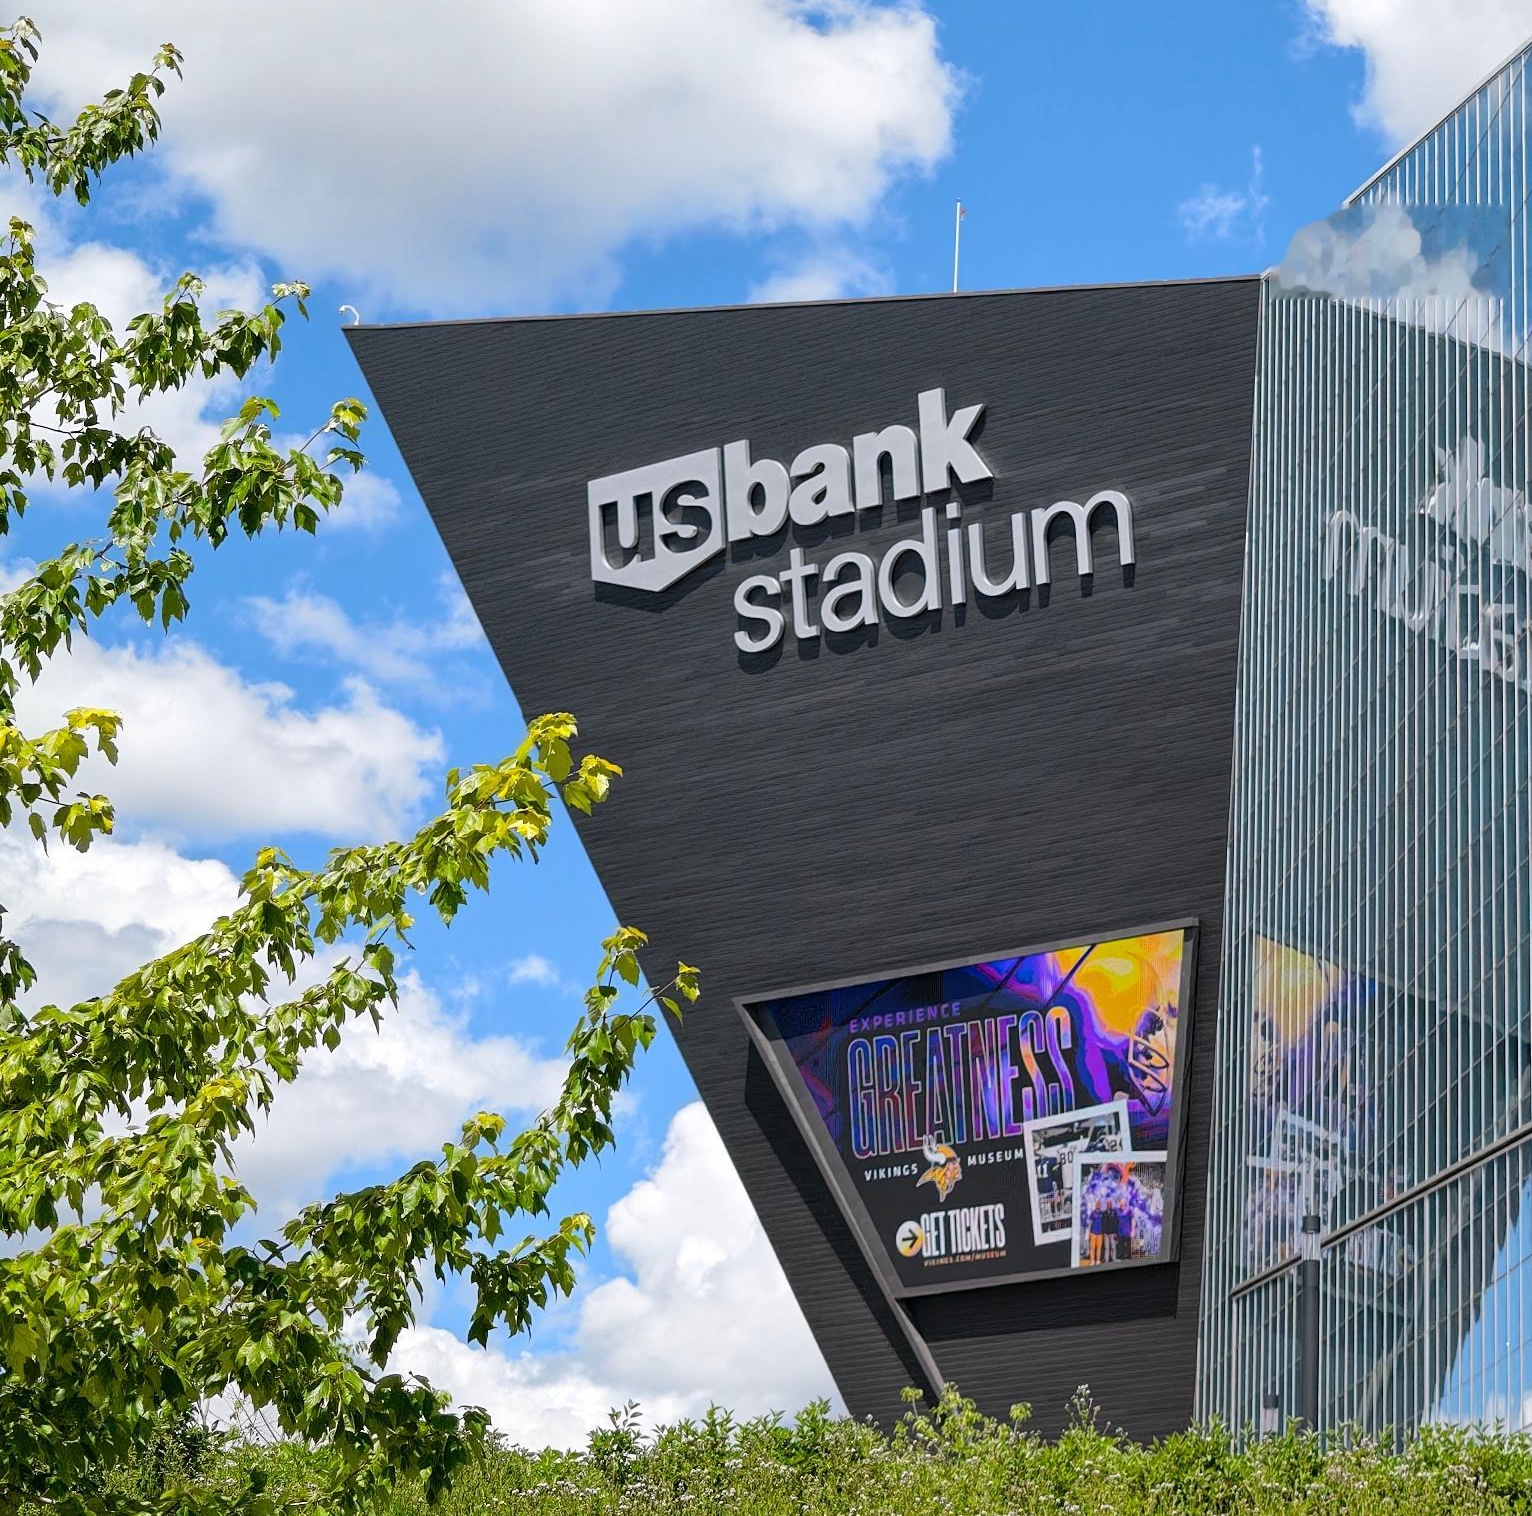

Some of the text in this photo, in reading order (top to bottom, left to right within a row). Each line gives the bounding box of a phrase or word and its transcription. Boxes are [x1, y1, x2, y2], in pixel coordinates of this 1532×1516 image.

[724, 387, 995, 543] bank
[734, 490, 1135, 653] stadium
[849, 1001, 961, 1034] EXPERIENCE
[847, 1005, 1075, 1160] GREATNESS
[864, 1147, 1024, 1181] VIKINGS MUSEUM
[920, 1202, 1006, 1258] GET TICKETS
